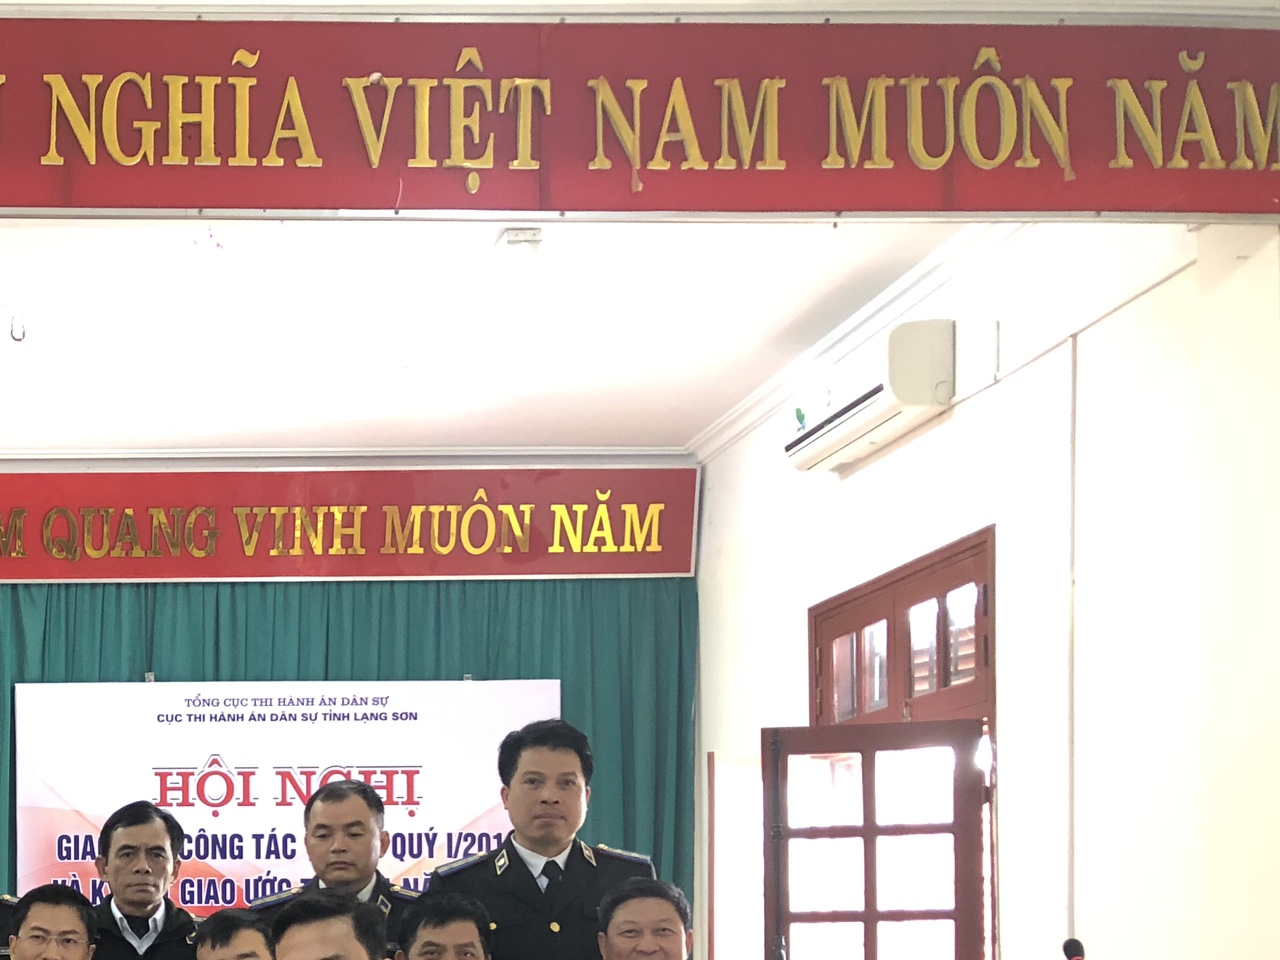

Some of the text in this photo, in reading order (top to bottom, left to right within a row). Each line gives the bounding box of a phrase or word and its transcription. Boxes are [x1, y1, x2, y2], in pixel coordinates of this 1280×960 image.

[40, 49, 323, 169] NGHĨA
[343, 47, 551, 194] VIỆT
[587, 75, 787, 191] NAM
[821, 46, 1074, 181] MUÔN
[1108, 49, 1280, 171] NĂM
[41, 506, 220, 564] QUANG
[233, 504, 367, 557] VINH
[381, 489, 535, 555] MUÔN
[547, 489, 665, 553] NĂM
[157, 709, 418, 725] CỤC THI HÀNH ÁN DÂN SỰ TỈNH LẠNG SƠN
[185, 693, 389, 709] TỔNG CỤC THI HÀNH ÁN DÂN SỰ
[154, 757, 257, 817] HỘI
[57, 834, 100, 860] GIA
[179, 828, 243, 860] CÔNG
[252, 827, 297, 859] TÁC
[392, 827, 438, 862] QUÝ
[180, 878, 235, 905] GIAO
